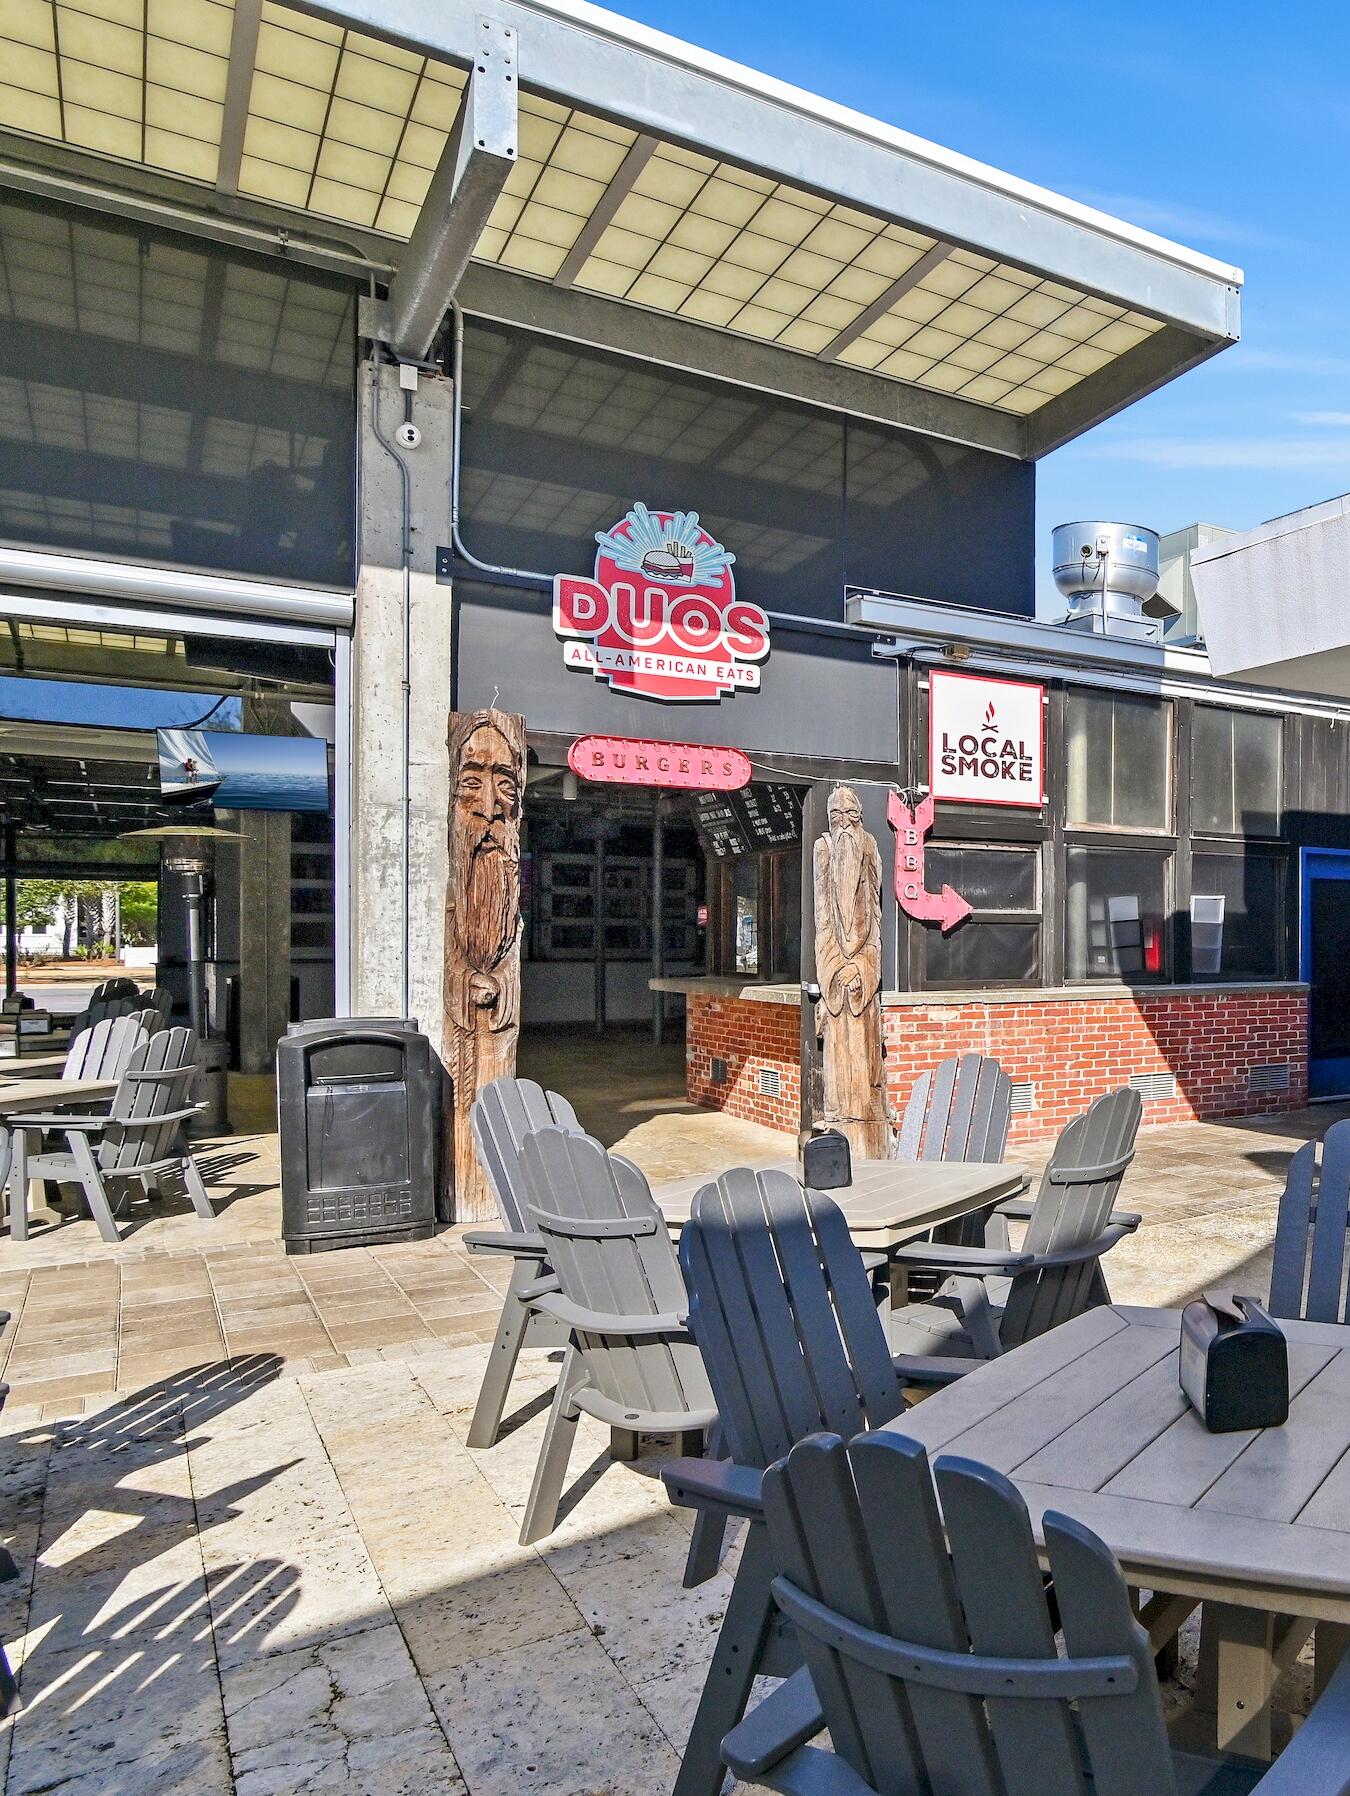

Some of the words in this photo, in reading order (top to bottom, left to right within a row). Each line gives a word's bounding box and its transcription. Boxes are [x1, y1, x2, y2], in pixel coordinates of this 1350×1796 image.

[559, 578, 765, 655] DUOS
[571, 648, 707, 676] ALL-AMERICAN
[716, 666, 755, 682] EATS
[942, 732, 1033, 761] LOCAL
[591, 751, 733, 777] BURGERS
[941, 754, 1033, 782] SMOKE
[903, 828, 919, 900] BBQ
